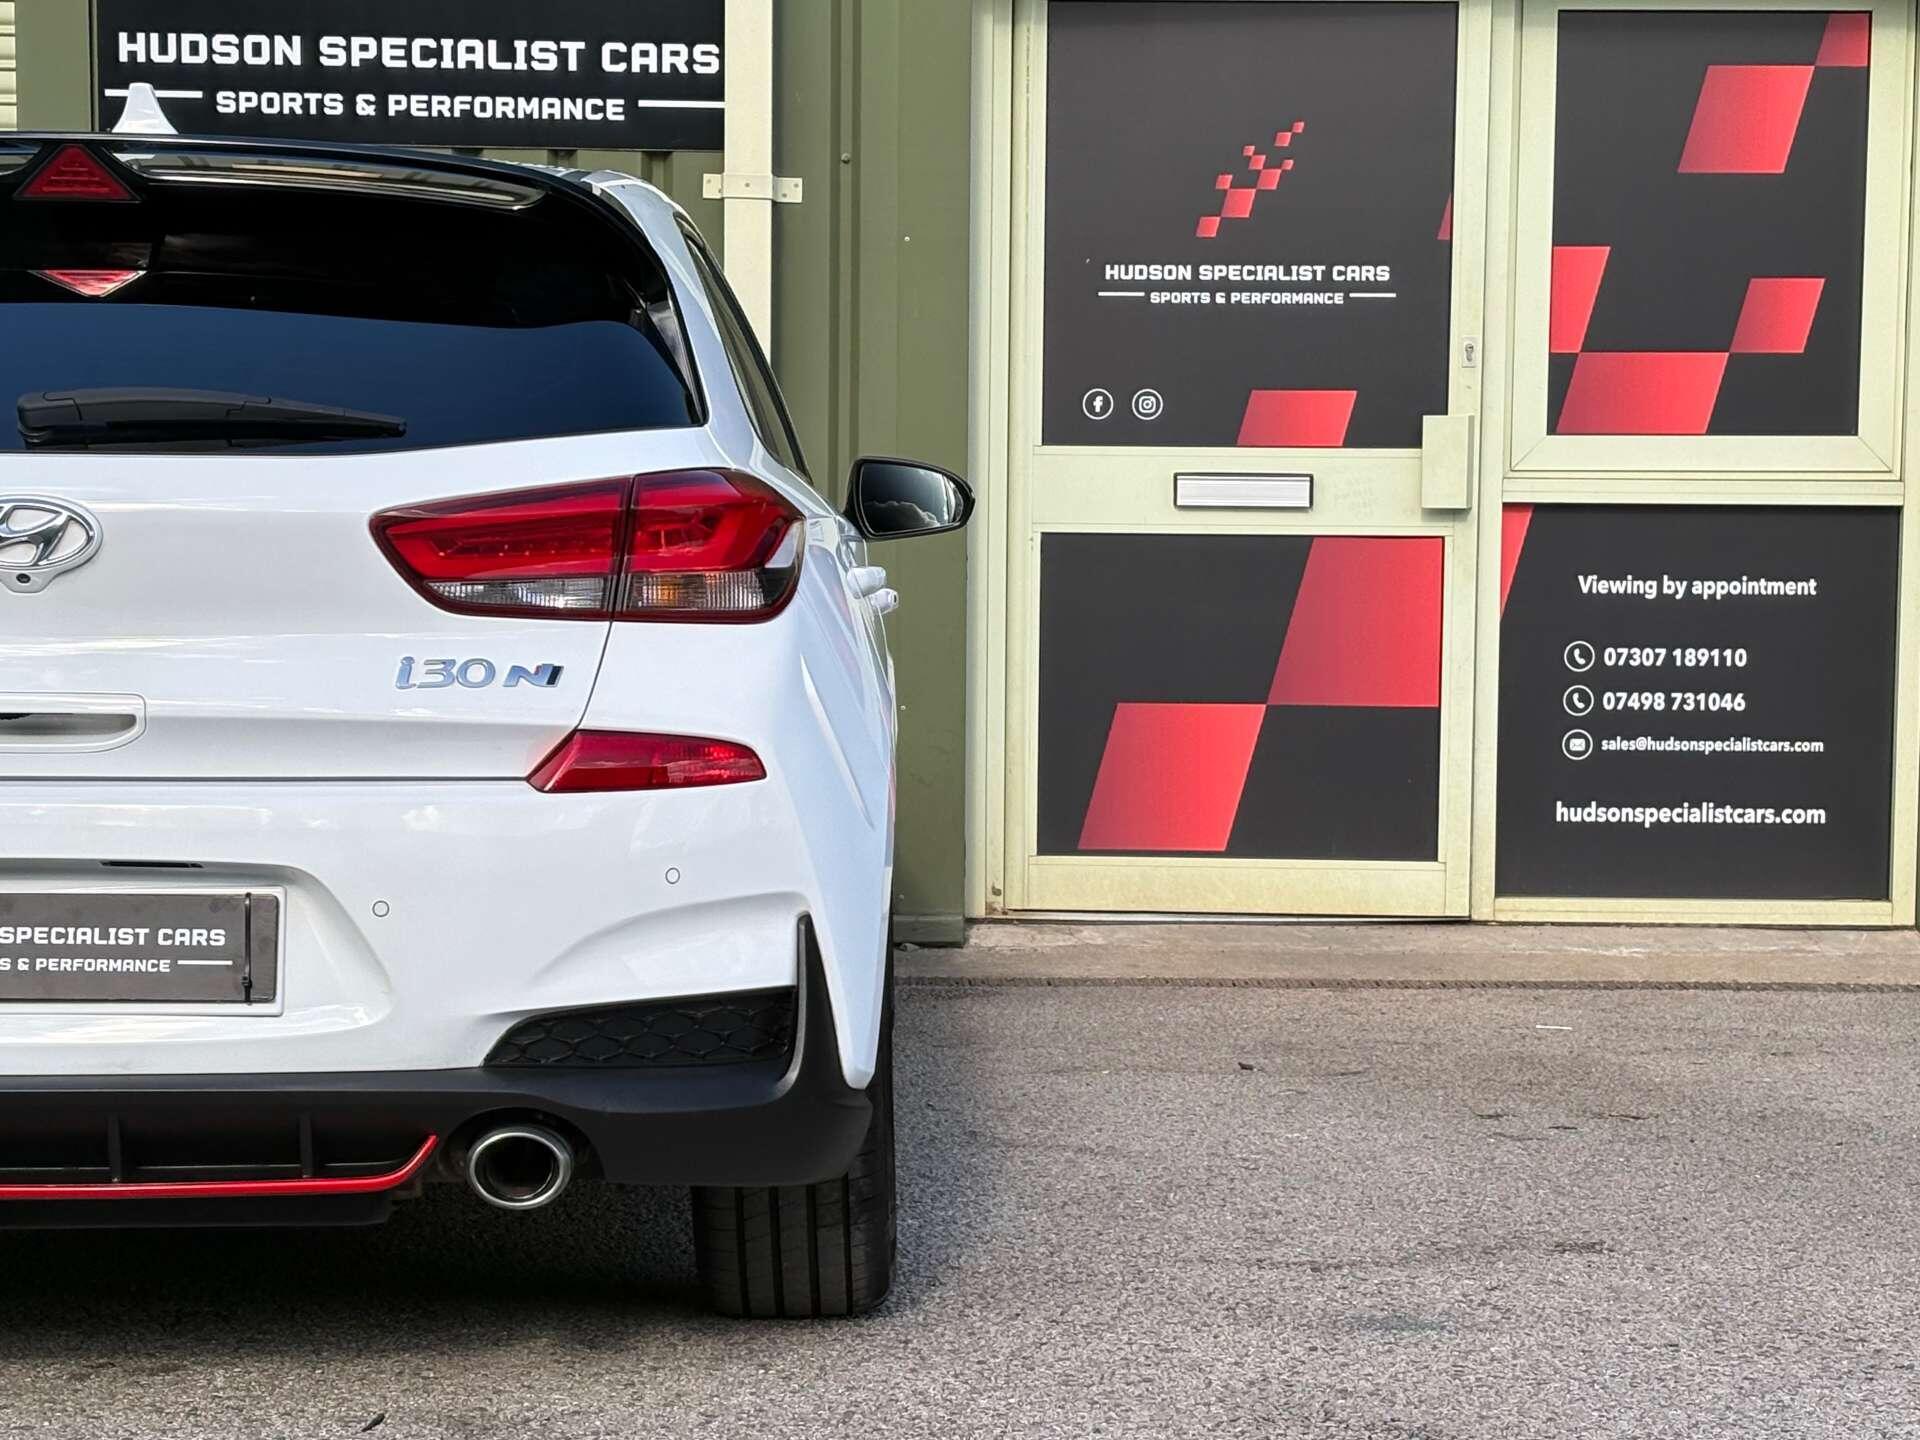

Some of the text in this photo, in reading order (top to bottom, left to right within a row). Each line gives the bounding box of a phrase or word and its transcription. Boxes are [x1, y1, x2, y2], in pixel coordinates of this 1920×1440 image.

[118, 31, 720, 74] HUDSON SPECIALIST CARS
[216, 90, 625, 121] SPORTS & PERFORMANCE
[1105, 264, 1390, 282] HUDSON SPECIALIST CARS
[1150, 291, 1344, 305] SPORTS & PERFORMANCE
[1577, 574, 1818, 600] Viewing by appointment
[1603, 647, 1748, 668] 07307 189110
[395, 656, 496, 689] i30
[1602, 691, 1746, 712] 07498 731046
[1601, 735, 1824, 755] sales@hudsonspecialistcars.com
[1556, 800, 1826, 829] hudsonspecialistcars.com
[0, 926, 226, 947] SPECIALIST CARS
[17, 957, 30, 971] &
[35, 958, 171, 973] PERFORMANCE
